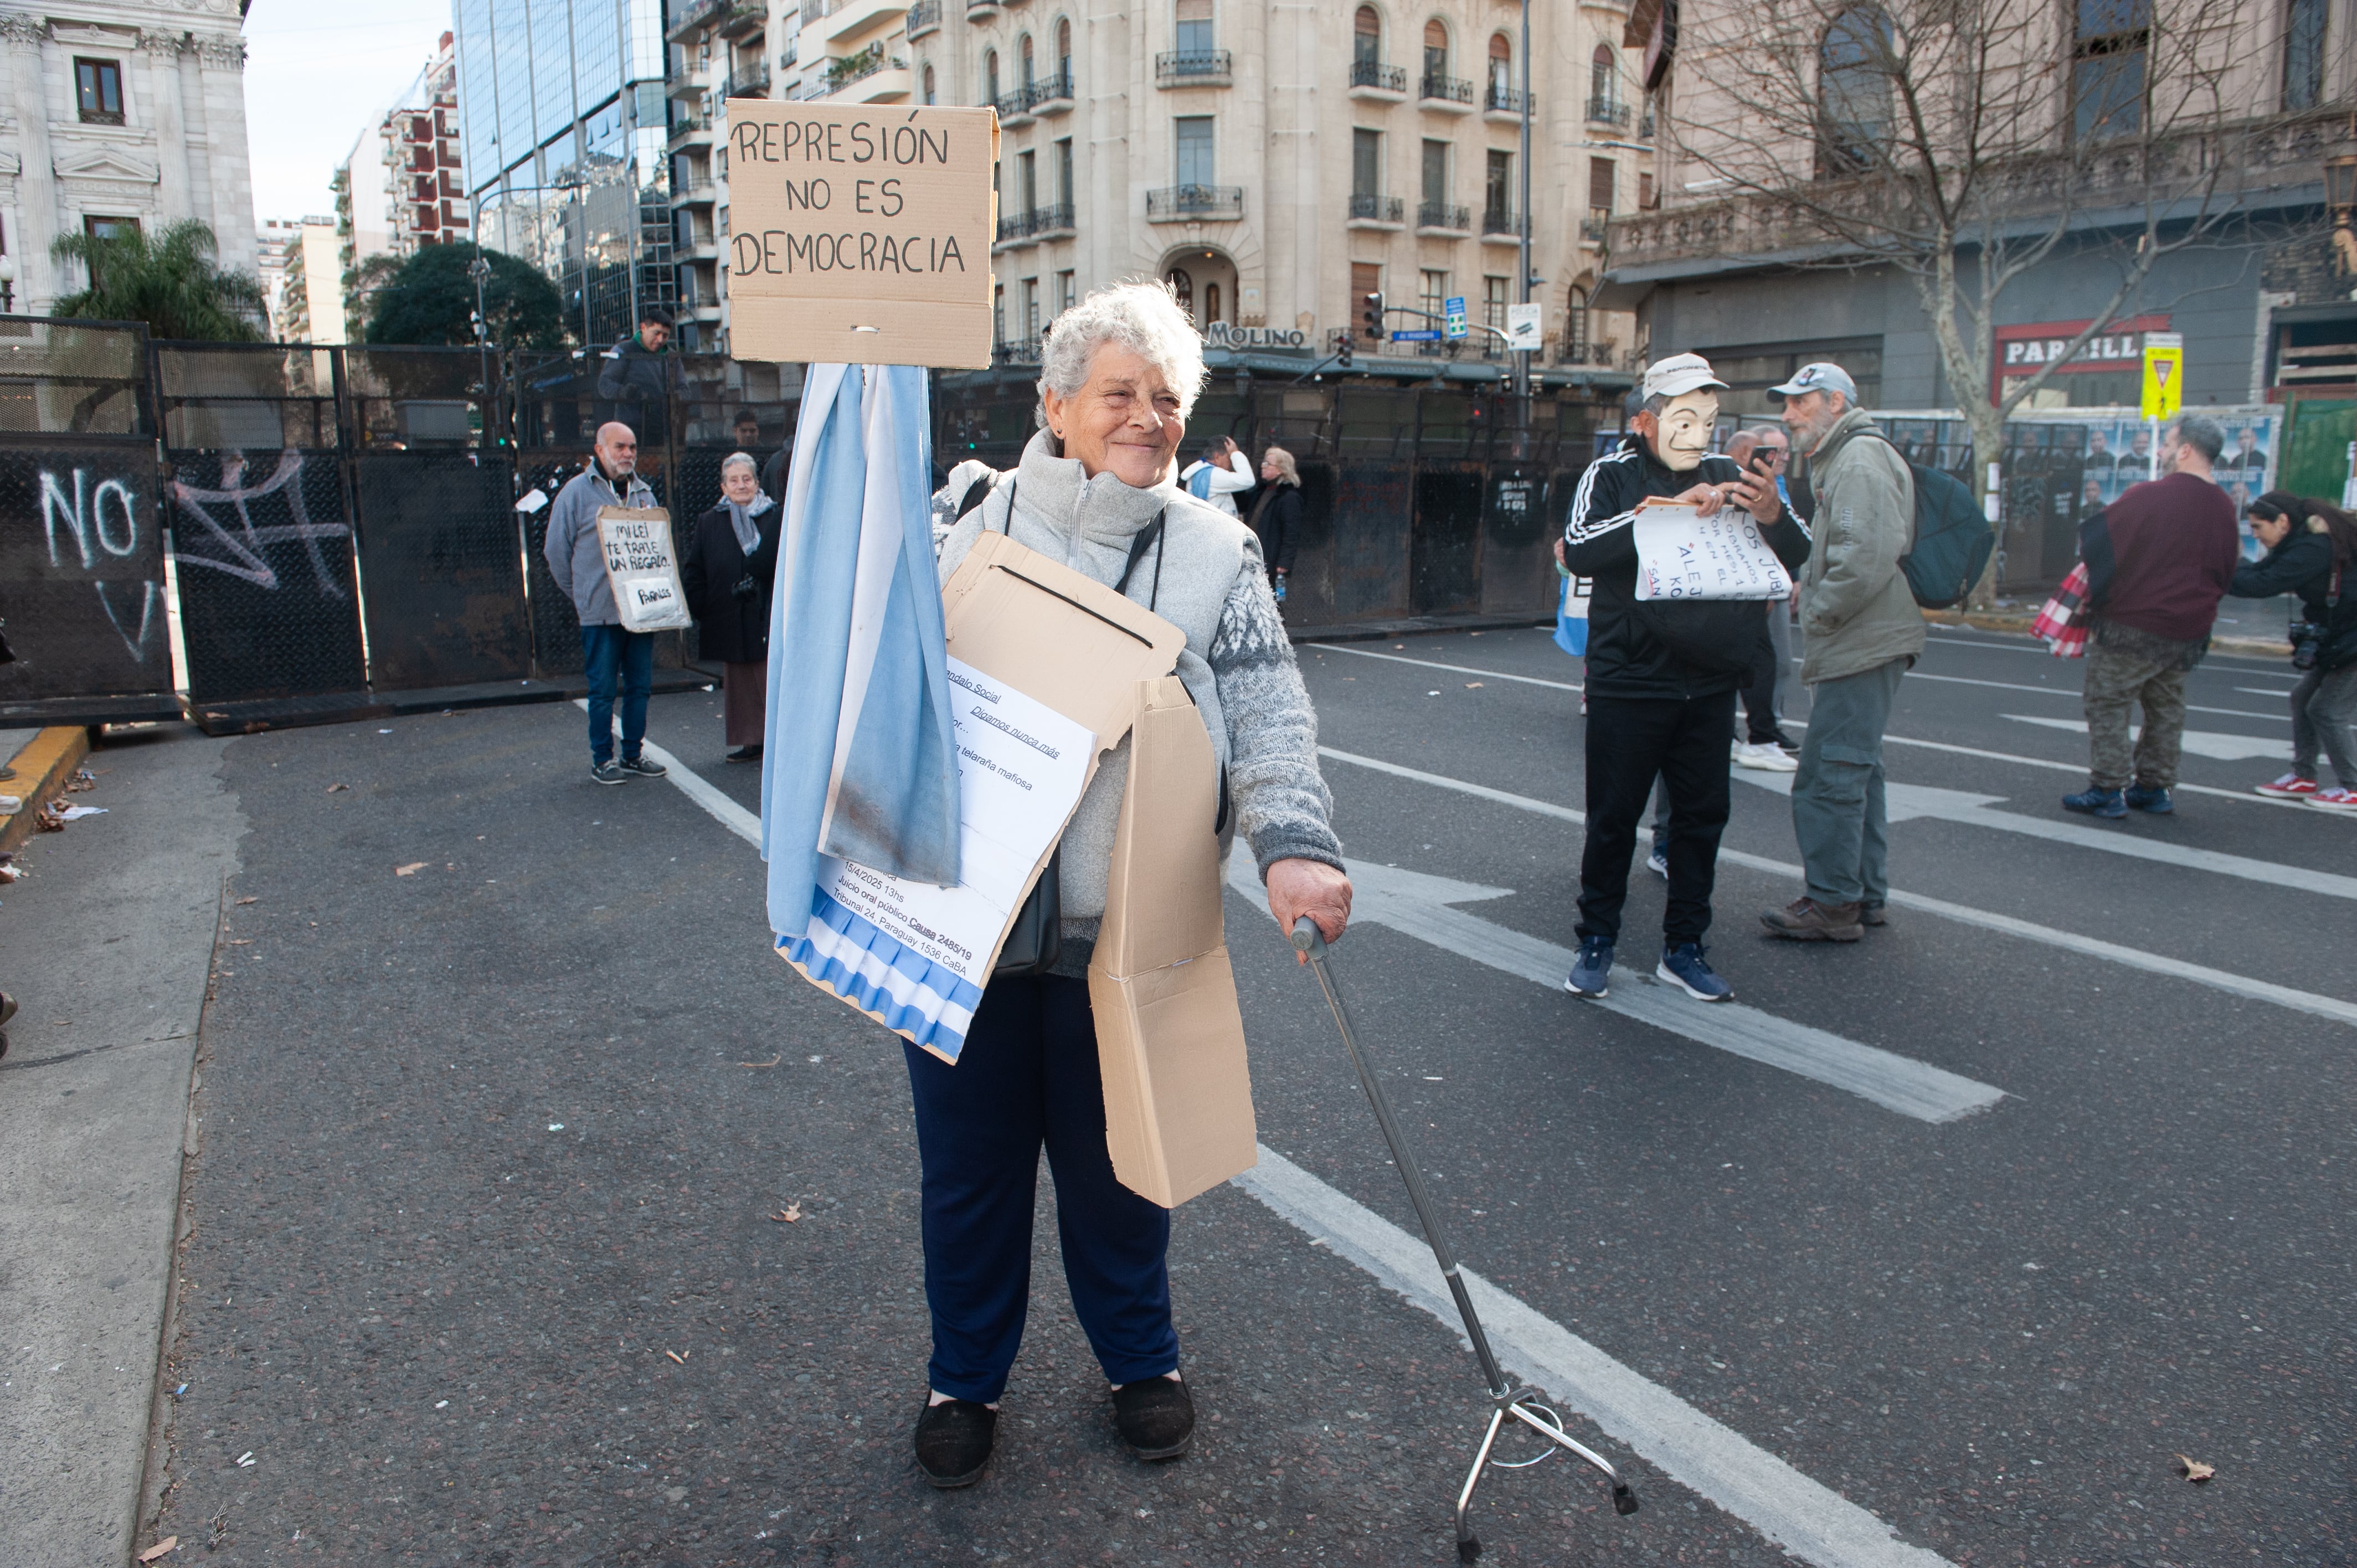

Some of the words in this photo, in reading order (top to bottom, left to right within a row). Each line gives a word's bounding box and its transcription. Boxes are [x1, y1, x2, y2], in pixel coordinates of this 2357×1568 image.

[730, 109, 948, 165] REPRESIÓN
[786, 178, 831, 210] NO
[856, 179, 904, 217] ES
[732, 230, 965, 276] DEMOCRACIA
[1208, 320, 1305, 350] MOLINO
[2006, 336, 2145, 363] PARILL
[40, 469, 136, 569] NO
[610, 558, 627, 571] UN
[974, 684, 1001, 703] Social
[971, 705, 1010, 731] Digamos
[1011, 728, 1039, 746] nunca
[1039, 742, 1061, 759] más
[961, 747, 996, 771] telaraña
[997, 767, 1032, 791] mafiosa
[845, 861, 883, 889] 15/4/2025
[885, 886, 904, 902] 13hs
[834, 888, 863, 912] Tribunal
[879, 916, 918, 947] Paraguay
[920, 942, 941, 959] 1536
[943, 956, 966, 976] CaBA
[838, 875, 860, 894] Juicio
[861, 890, 877, 904] oral
[877, 898, 908, 922] público
[908, 917, 937, 941] Causa
[937, 934, 972, 961] 2485/19
